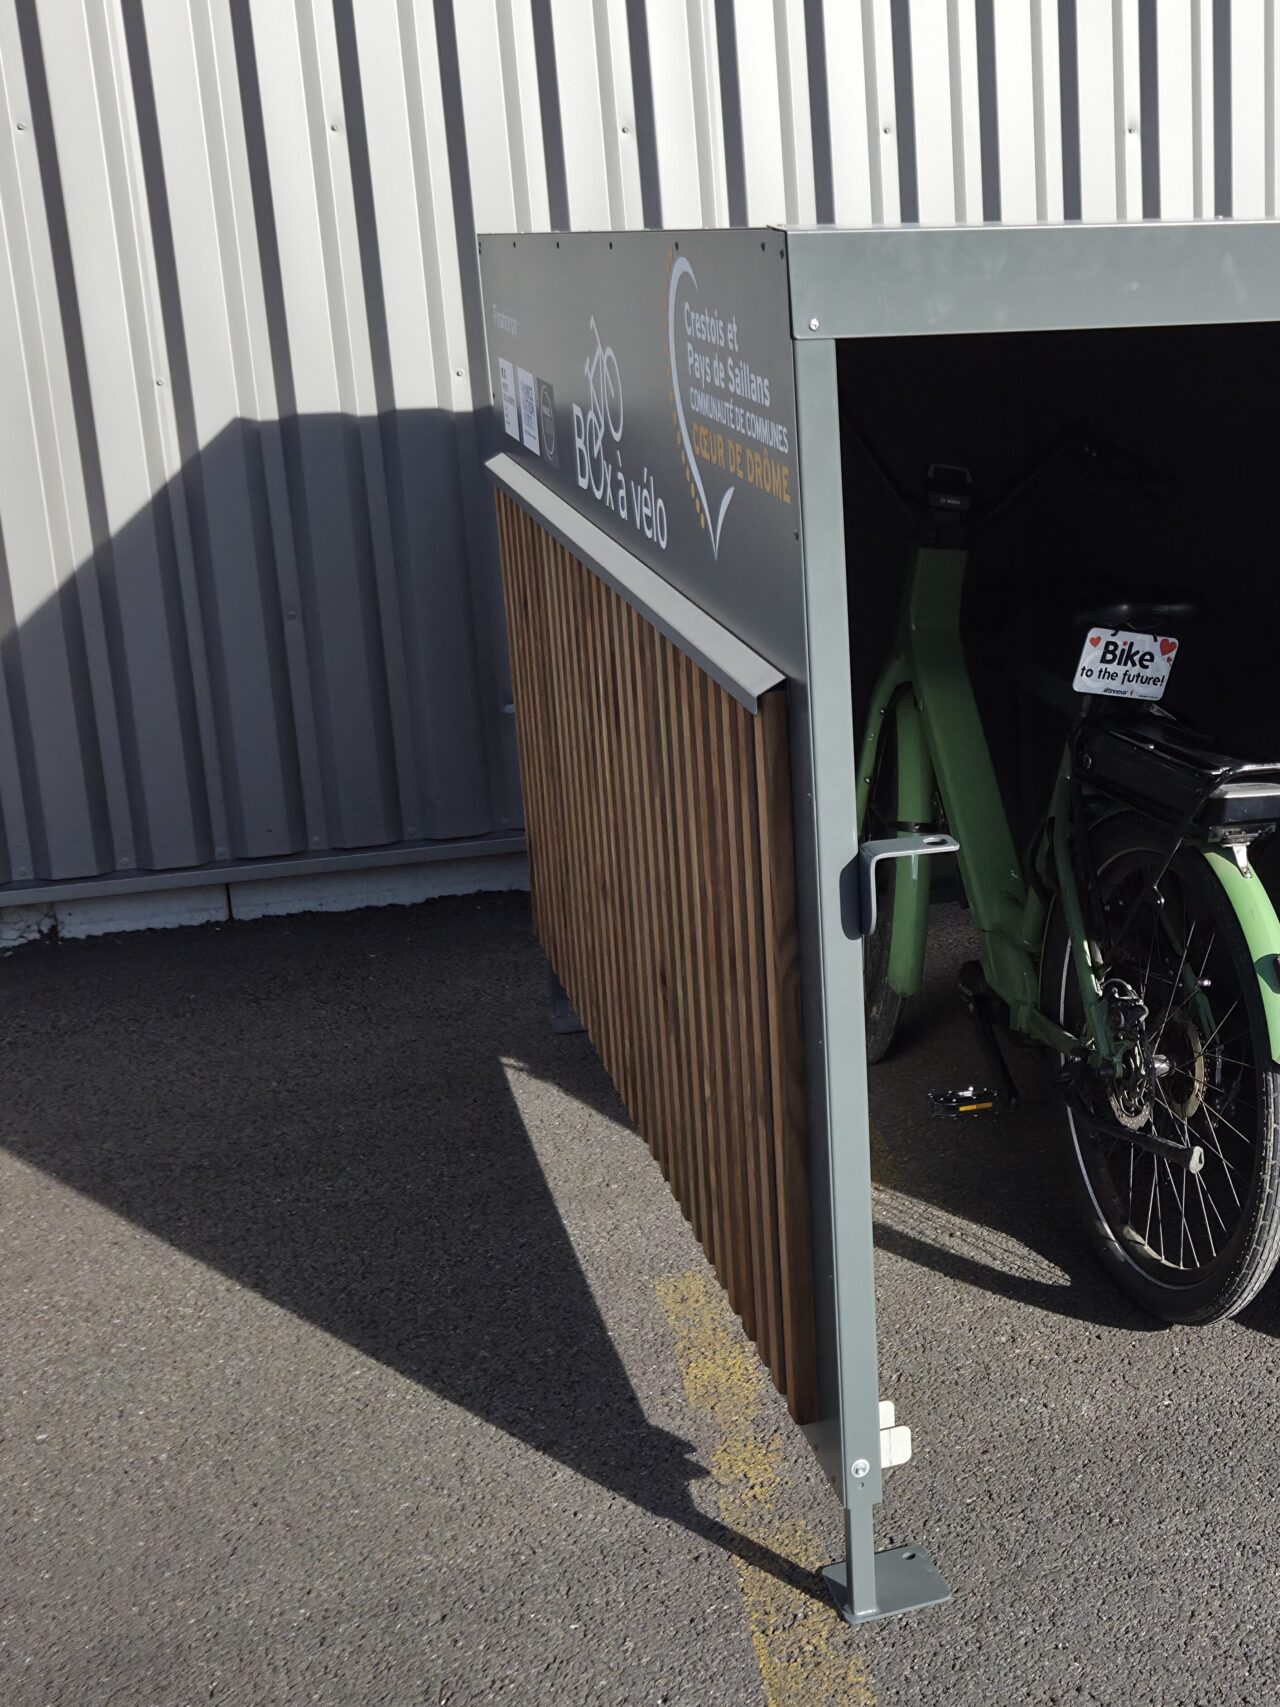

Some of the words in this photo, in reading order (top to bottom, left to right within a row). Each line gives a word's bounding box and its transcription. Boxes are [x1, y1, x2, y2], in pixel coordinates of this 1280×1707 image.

[684, 301, 725, 348] Crestois
[727, 314, 739, 352] et
[687, 341, 712, 389] Pays
[713, 352, 725, 389] de
[727, 356, 771, 408] Saillans
[690, 387, 736, 430] COMMUNAUTÉ
[735, 405, 746, 434] DE
[745, 410, 789, 454] COMMUNES
[617, 449, 628, 521] à
[631, 466, 668, 550] vélo
[728, 439, 744, 480] DE
[745, 447, 791, 504] DRÔME
[1080, 665, 1094, 679] to
[1097, 666, 1119, 682] the
[1120, 669, 1166, 687] future!
[1100, 640, 1155, 670] Bike
